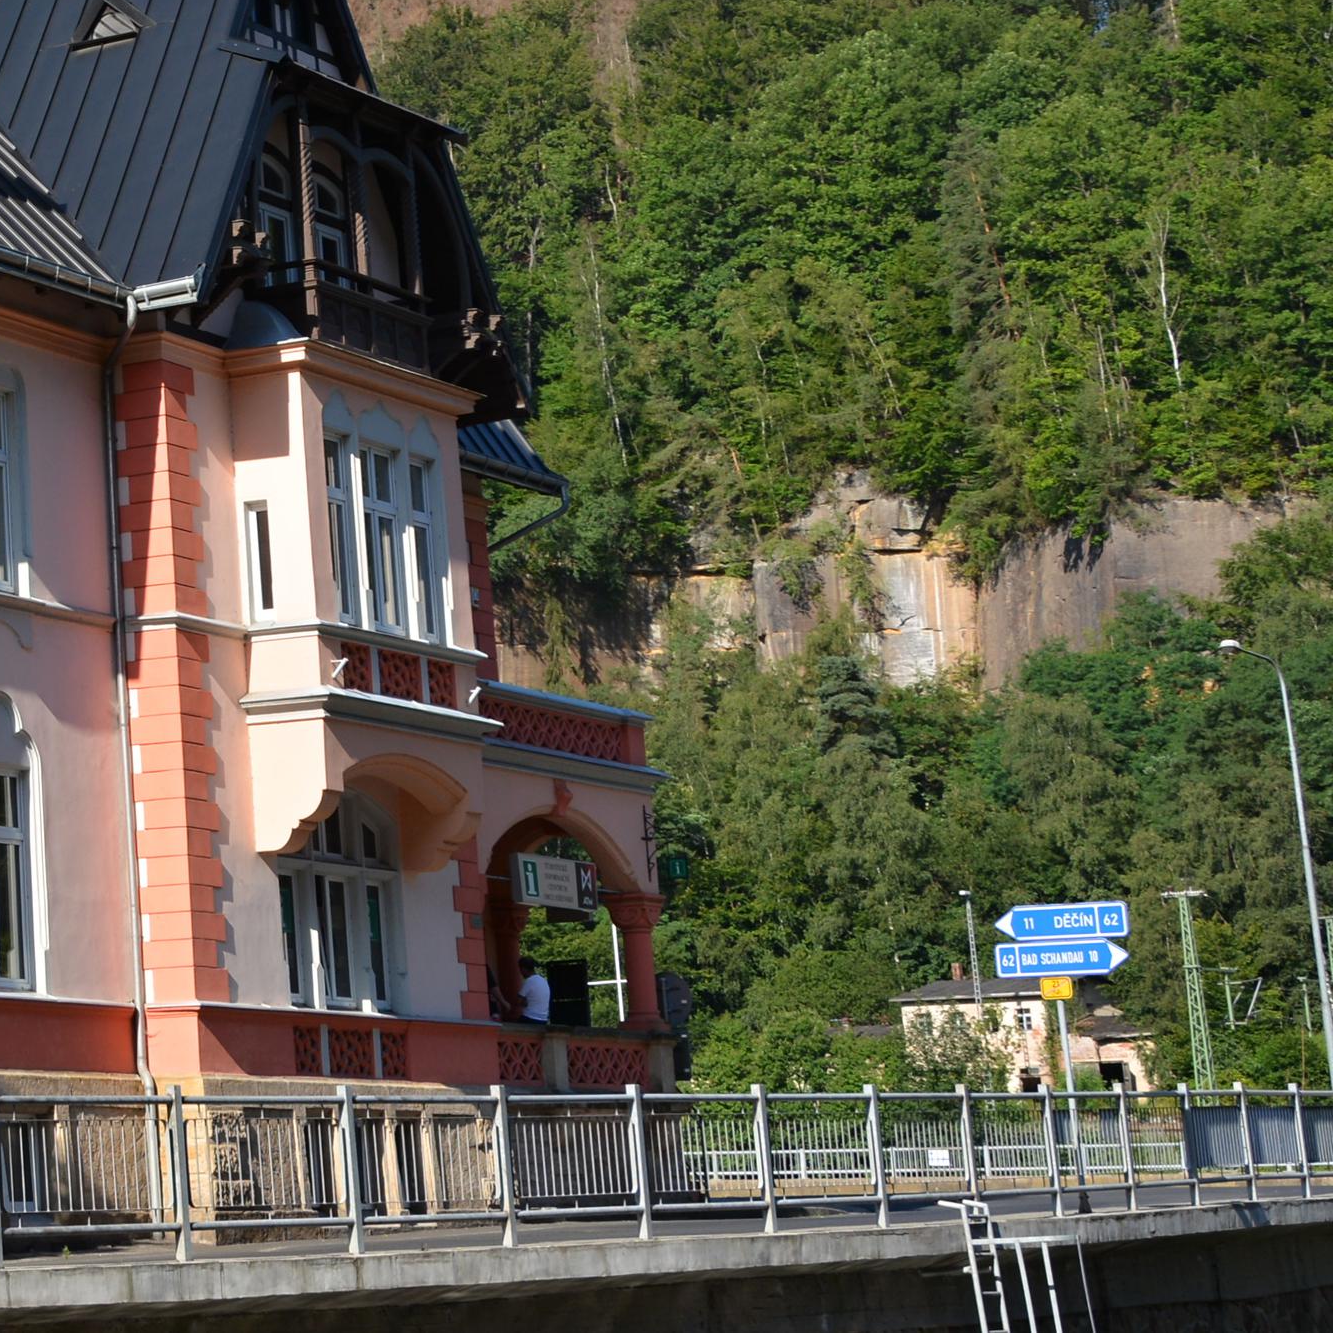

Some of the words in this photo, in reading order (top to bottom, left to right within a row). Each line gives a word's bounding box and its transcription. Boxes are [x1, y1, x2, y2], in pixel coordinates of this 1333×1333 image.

[1023, 918, 1034, 930] 11
[1054, 913, 1093, 928] DĚČÍN
[1103, 914, 1119, 926] 62
[1002, 955, 1015, 967] 62
[1021, 954, 1038, 966] BAD
[1041, 951, 1084, 965] SCHANDAU
[1089, 950, 1099, 963] 10
